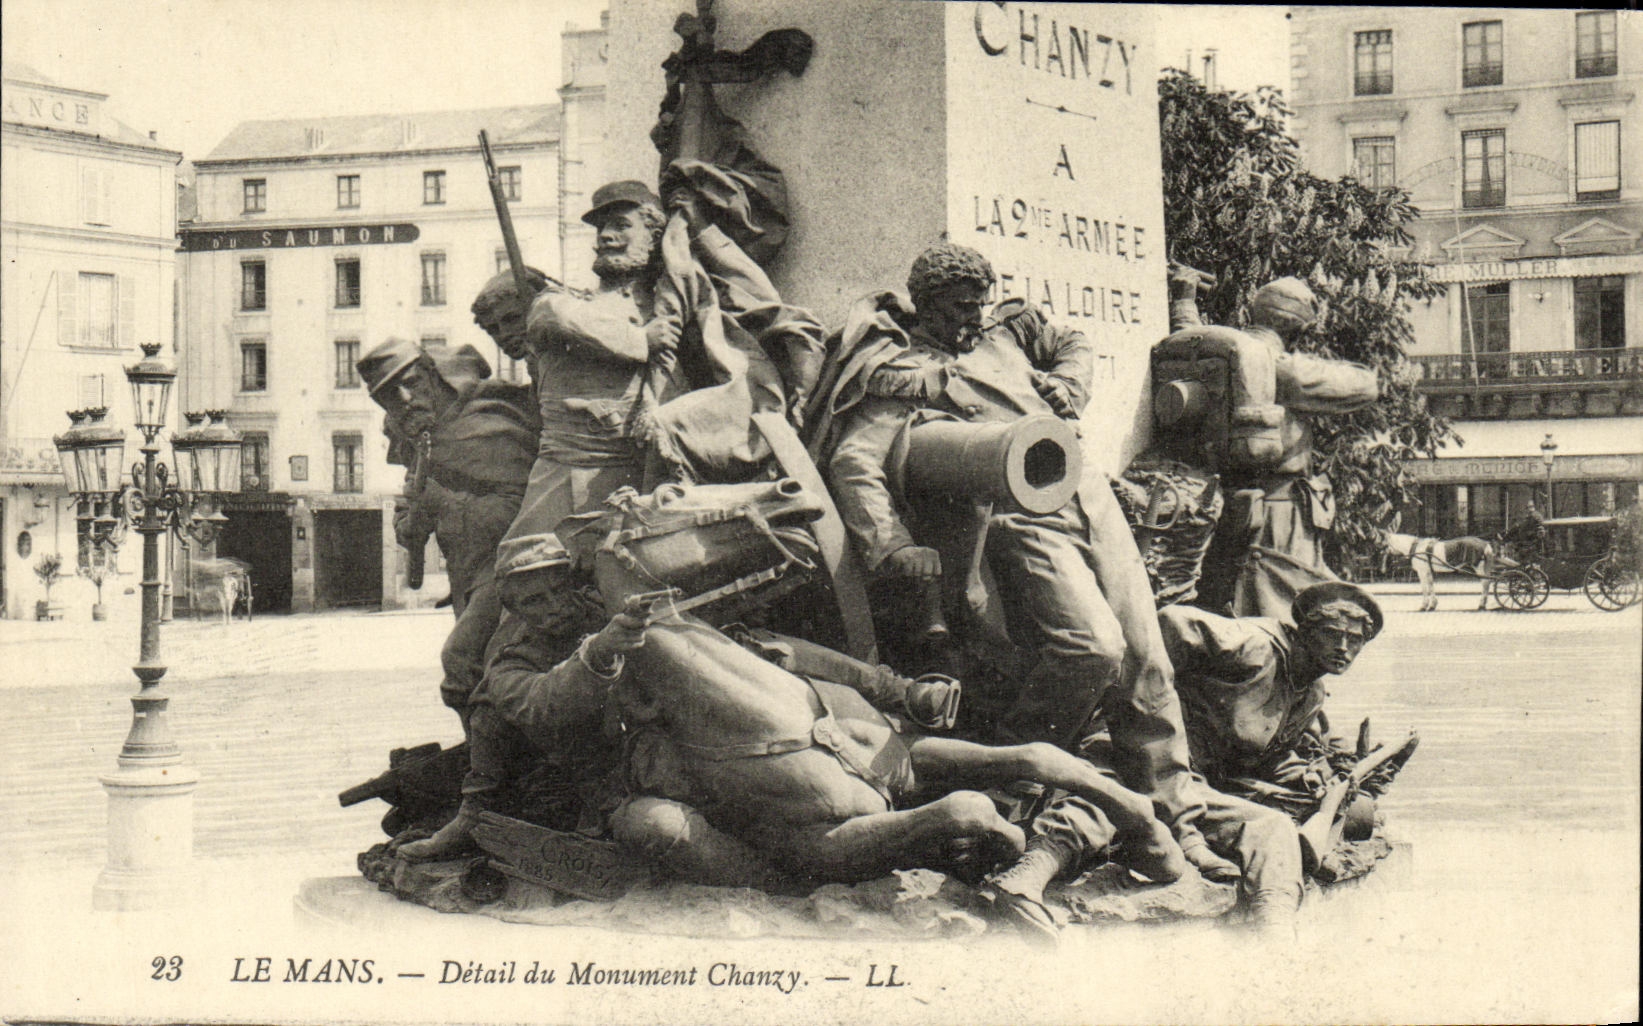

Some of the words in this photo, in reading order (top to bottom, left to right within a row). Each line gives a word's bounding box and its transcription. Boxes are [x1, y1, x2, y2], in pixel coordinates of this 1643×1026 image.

[974, 1, 1137, 96] CHANZY
[1053, 144, 1075, 181] A
[974, 195, 1005, 237] LA
[261, 227, 396, 248] SAUMON
[1468, 259, 1559, 278] MULLER
[1066, 282, 1141, 324] LOIRE
